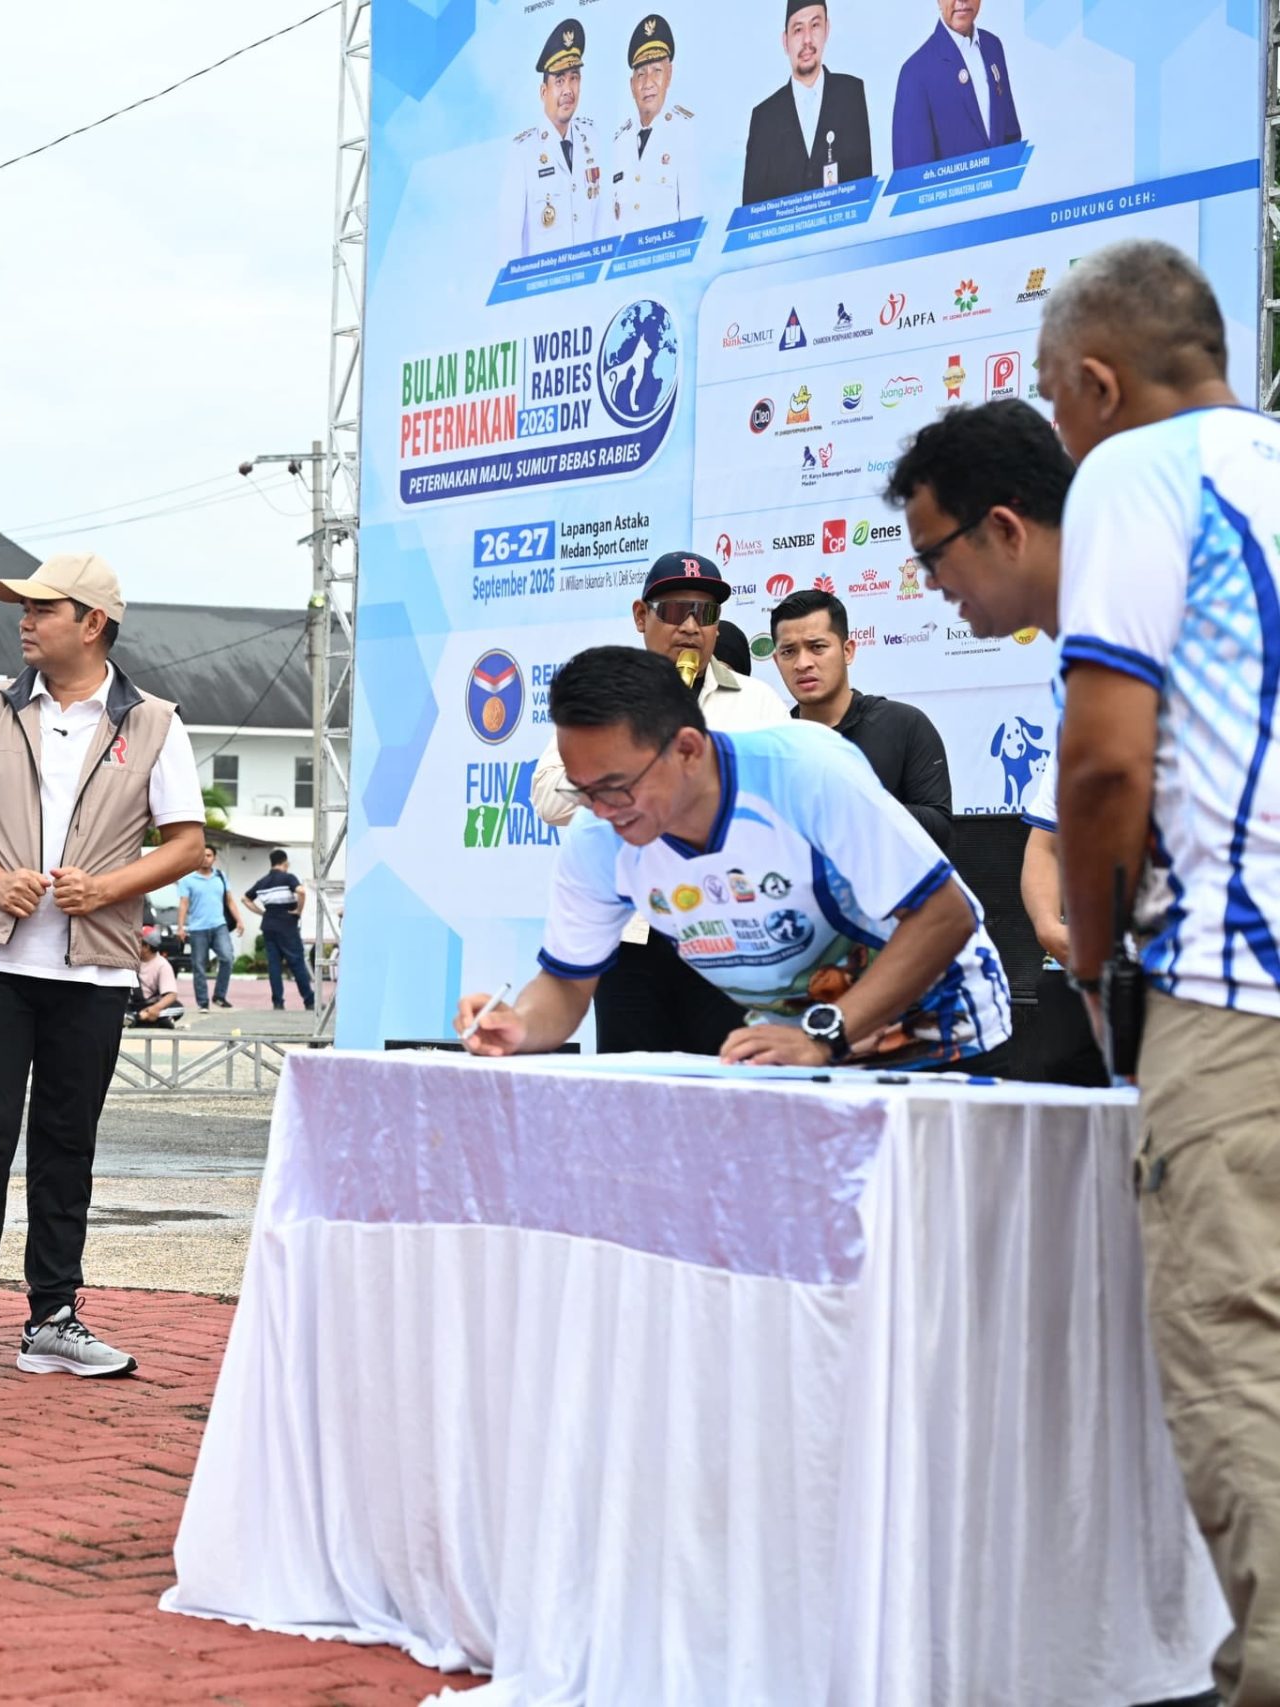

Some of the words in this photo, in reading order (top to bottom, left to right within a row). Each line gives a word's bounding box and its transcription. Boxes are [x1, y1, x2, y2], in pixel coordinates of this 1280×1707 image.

[1050, 199, 1114, 223] DIDUKUNG
[1119, 191, 1156, 208] OLEH:
[897, 310, 936, 330] JAPFA
[533, 325, 592, 364] WORLD
[402, 352, 458, 407] BULAN
[465, 340, 517, 395] BAKTI
[531, 362, 592, 400] RABIES
[843, 384, 862, 397] SKP
[401, 394, 516, 459] PETERNAKAN
[520, 409, 554, 436] 2026
[560, 398, 592, 432] DAY
[409, 470, 478, 495] PETERNAKAN
[479, 462, 513, 485] MAJU,
[516, 455, 558, 479] SUMUT
[559, 448, 596, 471] BEBAS
[598, 443, 641, 466] RABIES
[561, 519, 612, 538] Lapangan
[614, 512, 650, 531] Astaka
[870, 525, 901, 539] enes
[480, 527, 549, 562] 26-27
[560, 541, 591, 559] Medan
[593, 540, 617, 558] Sport
[619, 537, 649, 553] Center
[772, 534, 815, 550] SANBE
[829, 538, 845, 553] CP
[681, 558, 701, 578] B
[473, 570, 527, 605] September
[530, 568, 555, 595] 2026
[731, 584, 757, 595] STAGI
[849, 582, 868, 593] ROYAL
[869, 580, 890, 591] CANIN
[849, 625, 875, 639] ricell
[466, 762, 508, 804] FUN
